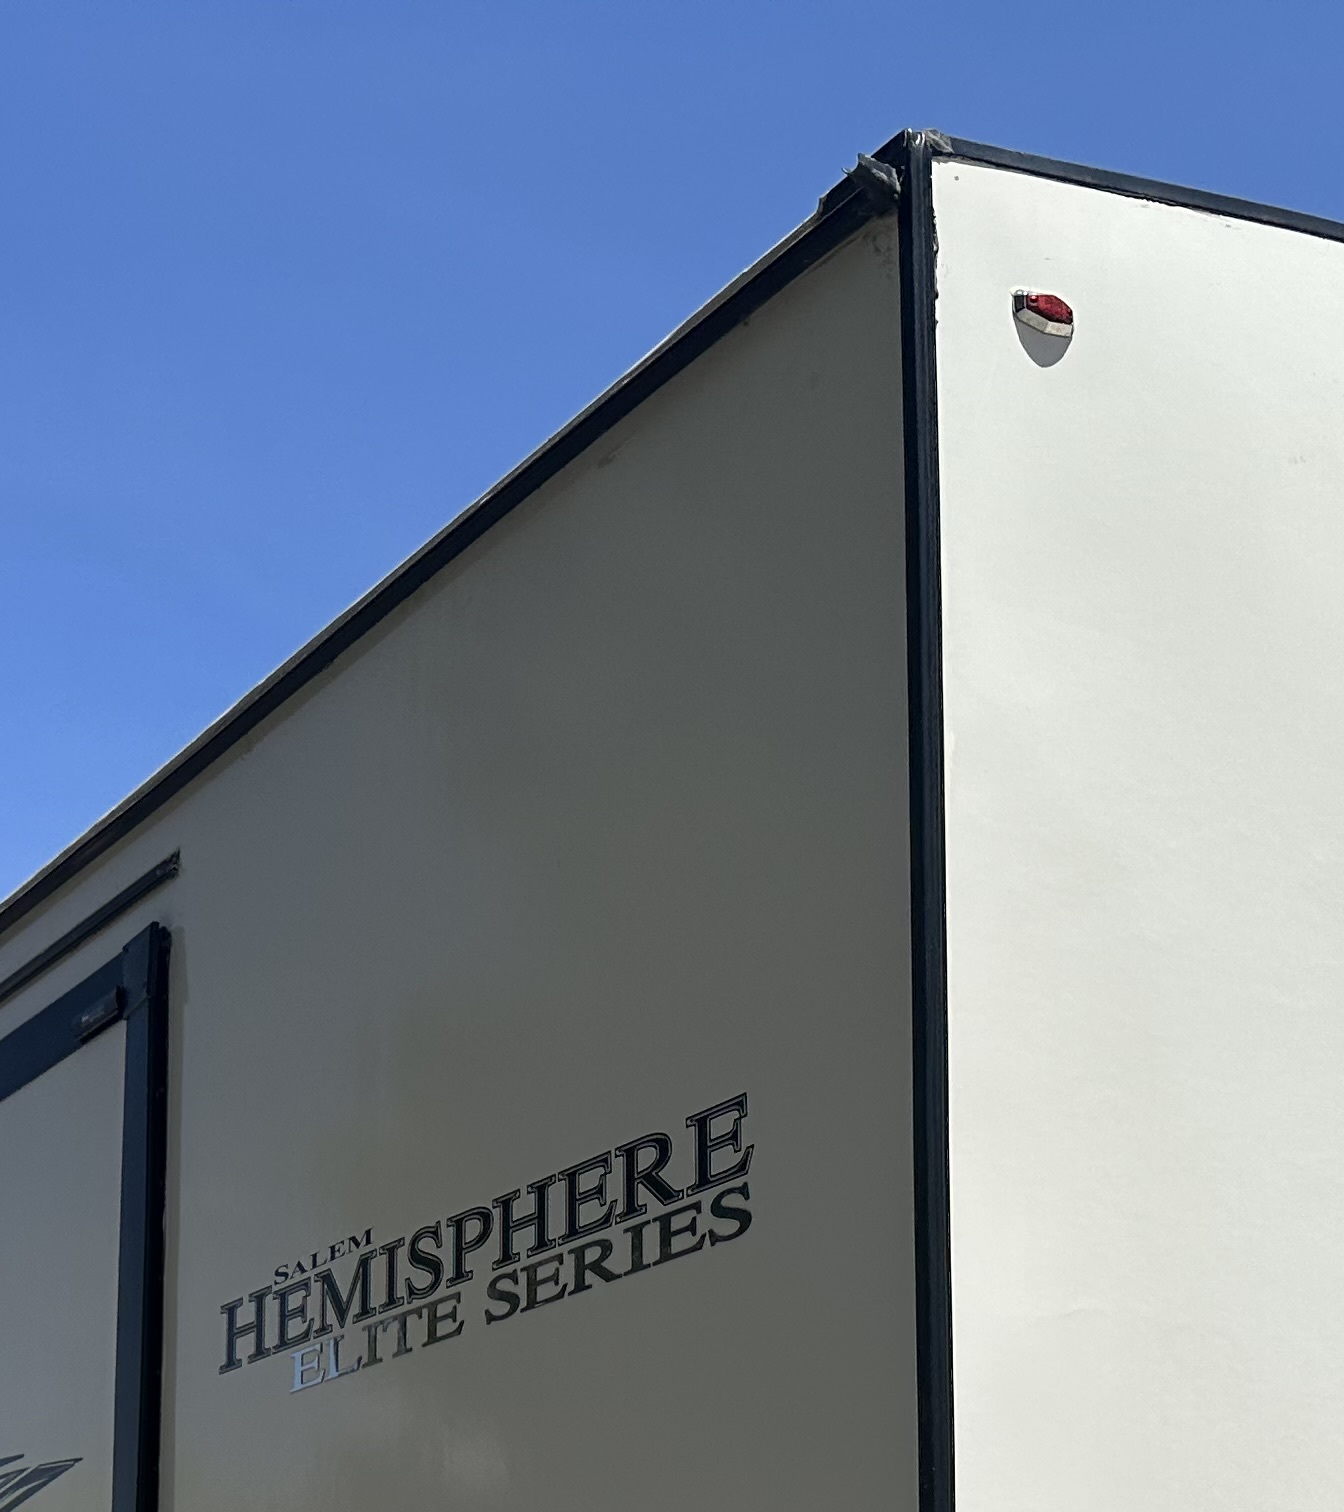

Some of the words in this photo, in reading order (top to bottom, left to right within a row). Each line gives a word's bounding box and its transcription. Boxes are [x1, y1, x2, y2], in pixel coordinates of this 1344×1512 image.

[218, 1092, 755, 1374] HEMISPHERE
[273, 1228, 374, 1285] SALEM
[289, 1292, 465, 1393] ELITE
[484, 1182, 753, 1325] SERIES
